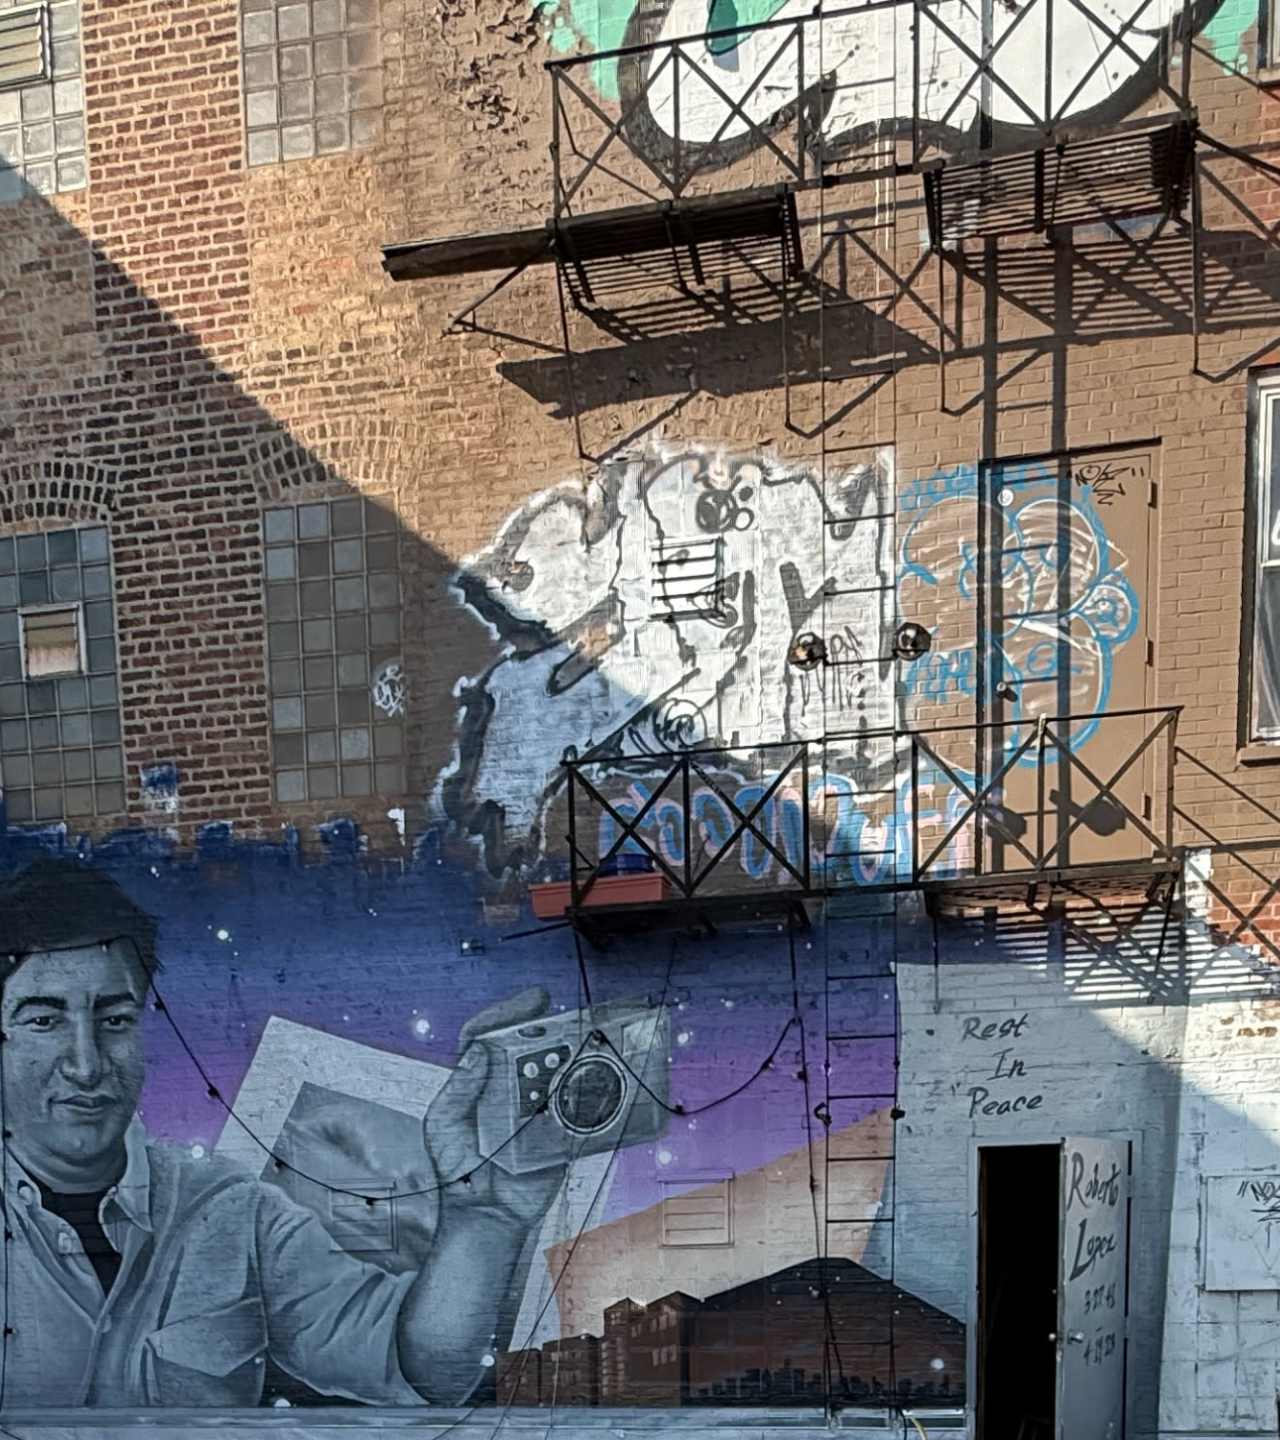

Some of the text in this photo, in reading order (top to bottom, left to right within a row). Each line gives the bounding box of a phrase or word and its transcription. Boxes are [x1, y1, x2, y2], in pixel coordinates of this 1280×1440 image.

[962, 1012, 1029, 1042] Rest
[985, 1047, 1027, 1081] In
[966, 1086, 1043, 1119] Peace
[1066, 1151, 1122, 1212] Roberto
